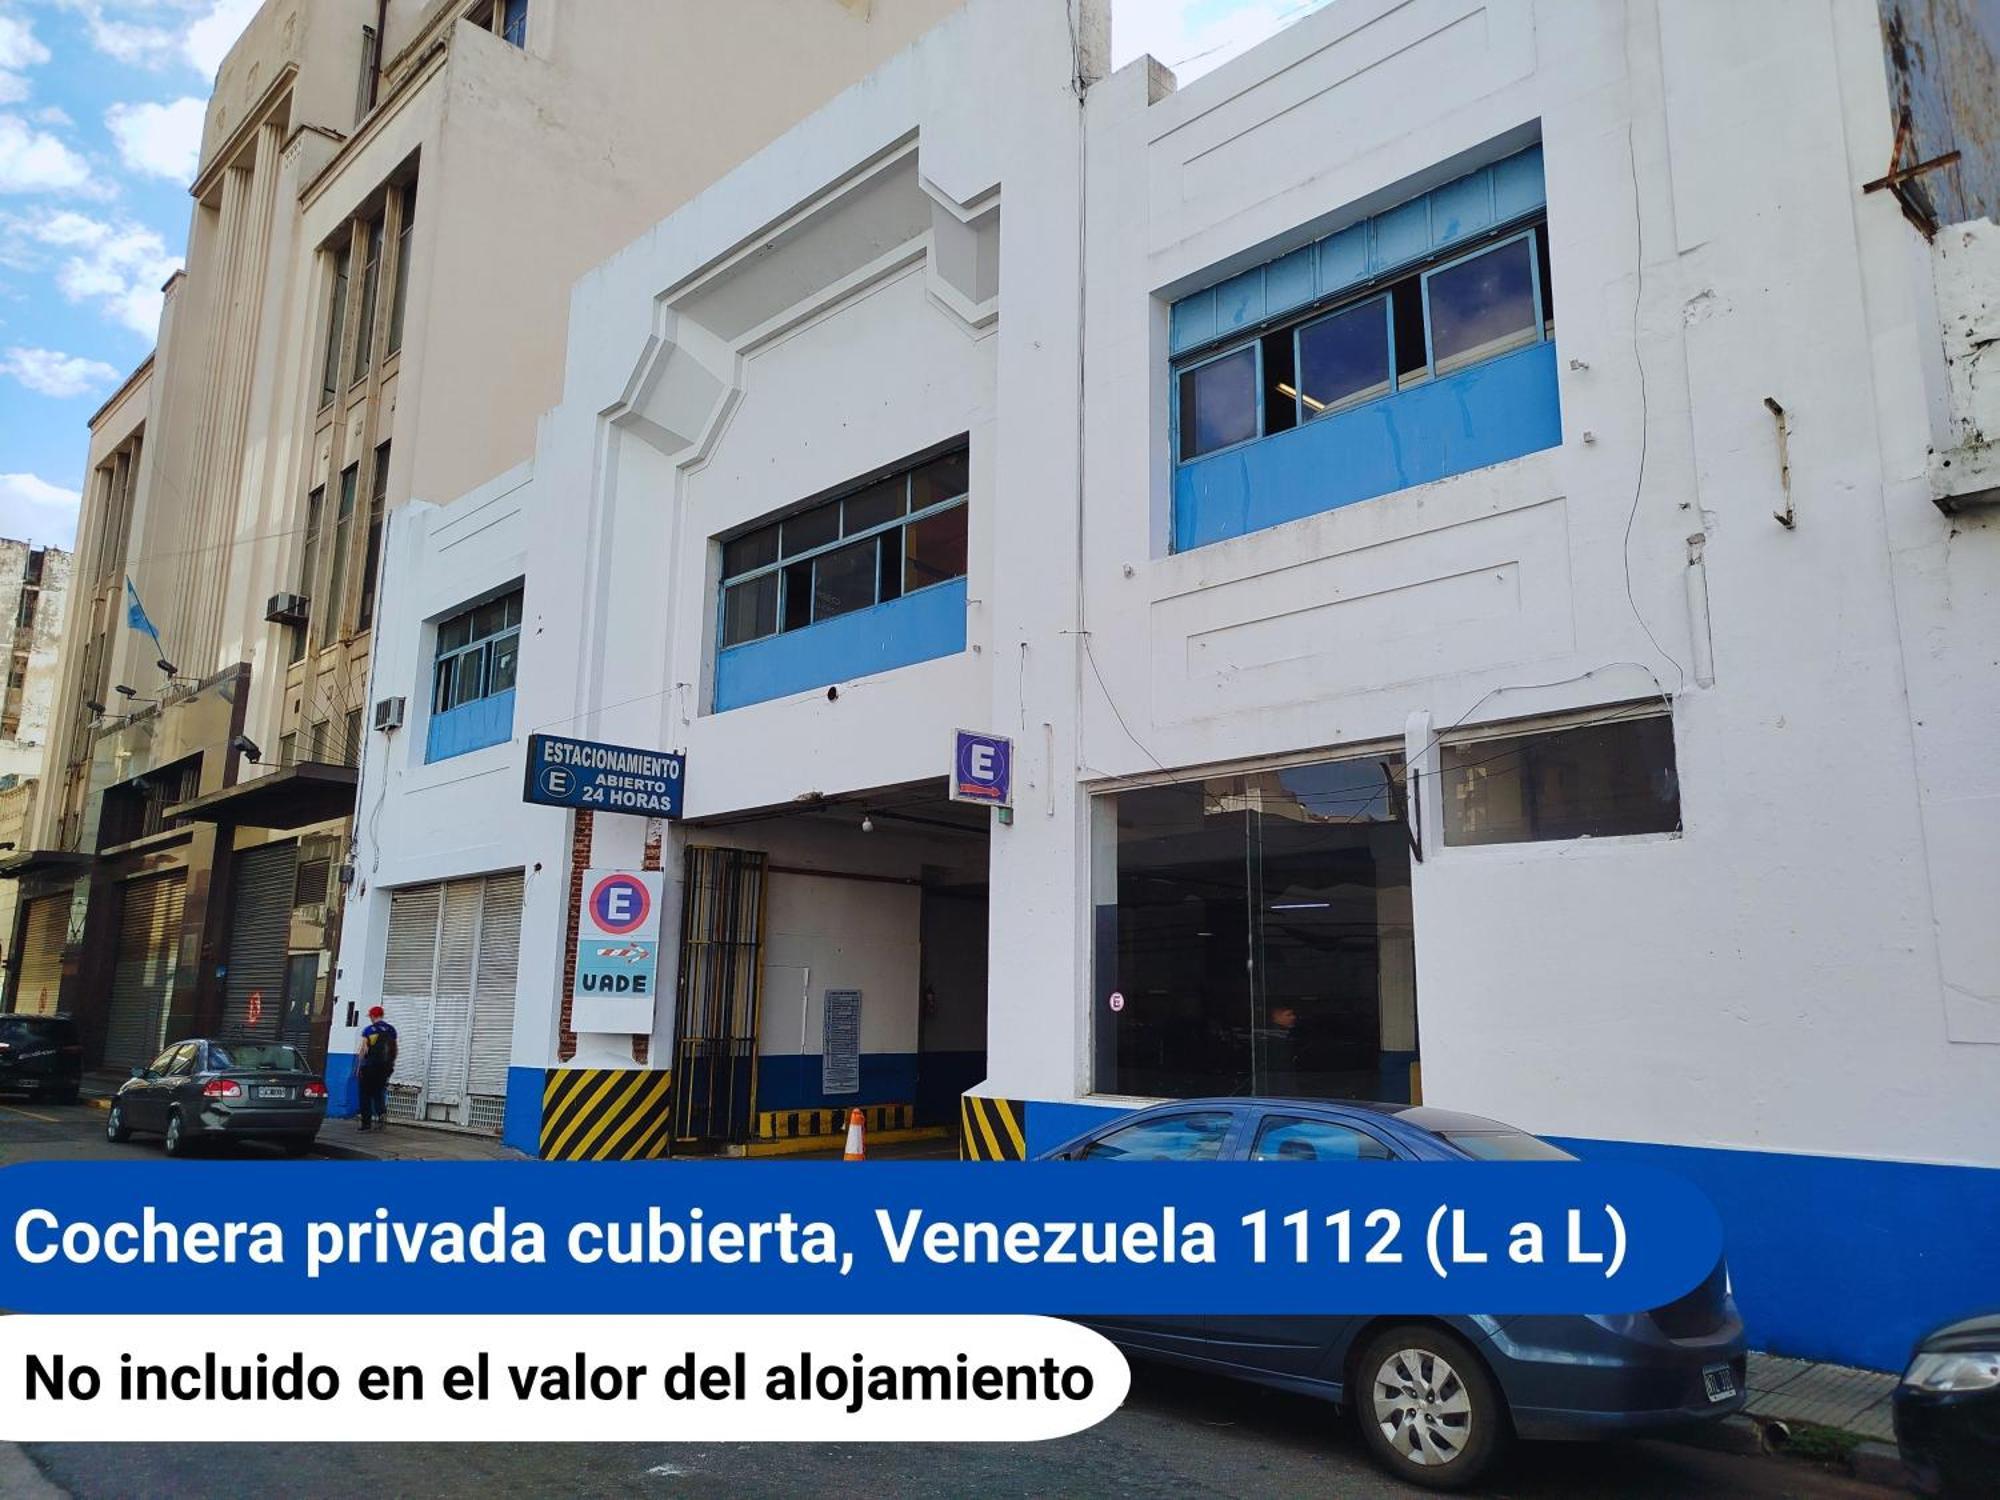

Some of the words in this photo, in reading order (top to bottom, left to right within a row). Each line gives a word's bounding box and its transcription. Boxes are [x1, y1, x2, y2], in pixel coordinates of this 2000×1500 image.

[543, 740, 680, 780] ESTACIONAMIENTO
[971, 743, 995, 781] E
[548, 771, 567, 793] E
[595, 773, 666, 793] ABIERTO
[582, 786, 605, 802] 24
[610, 789, 672, 812] HORAS
[607, 887, 633, 920] E
[582, 973, 647, 993] UADE
